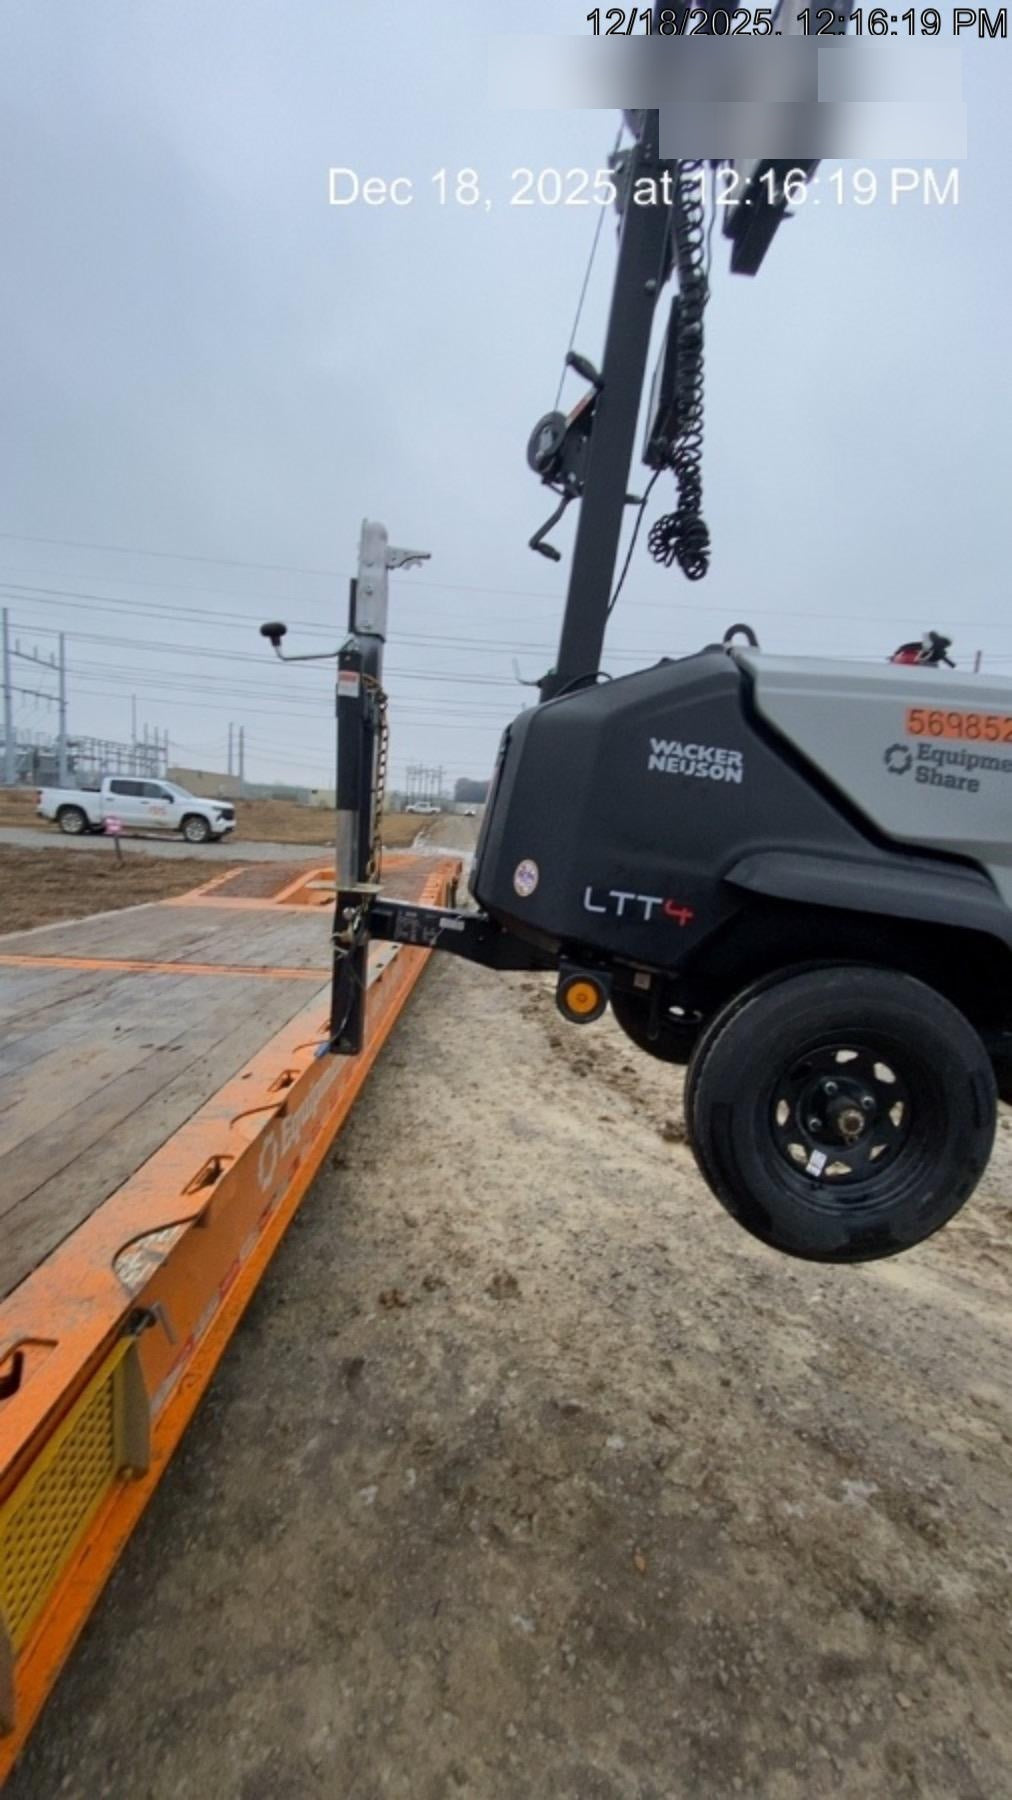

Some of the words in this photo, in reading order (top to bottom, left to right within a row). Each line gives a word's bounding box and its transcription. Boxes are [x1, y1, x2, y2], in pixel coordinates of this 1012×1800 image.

[908, 708, 1012, 742] 569852
[649, 737, 743, 767] WACKER
[647, 754, 743, 784] NEUSON
[914, 765, 980, 793] Share
[583, 886, 694, 927] LTT4
